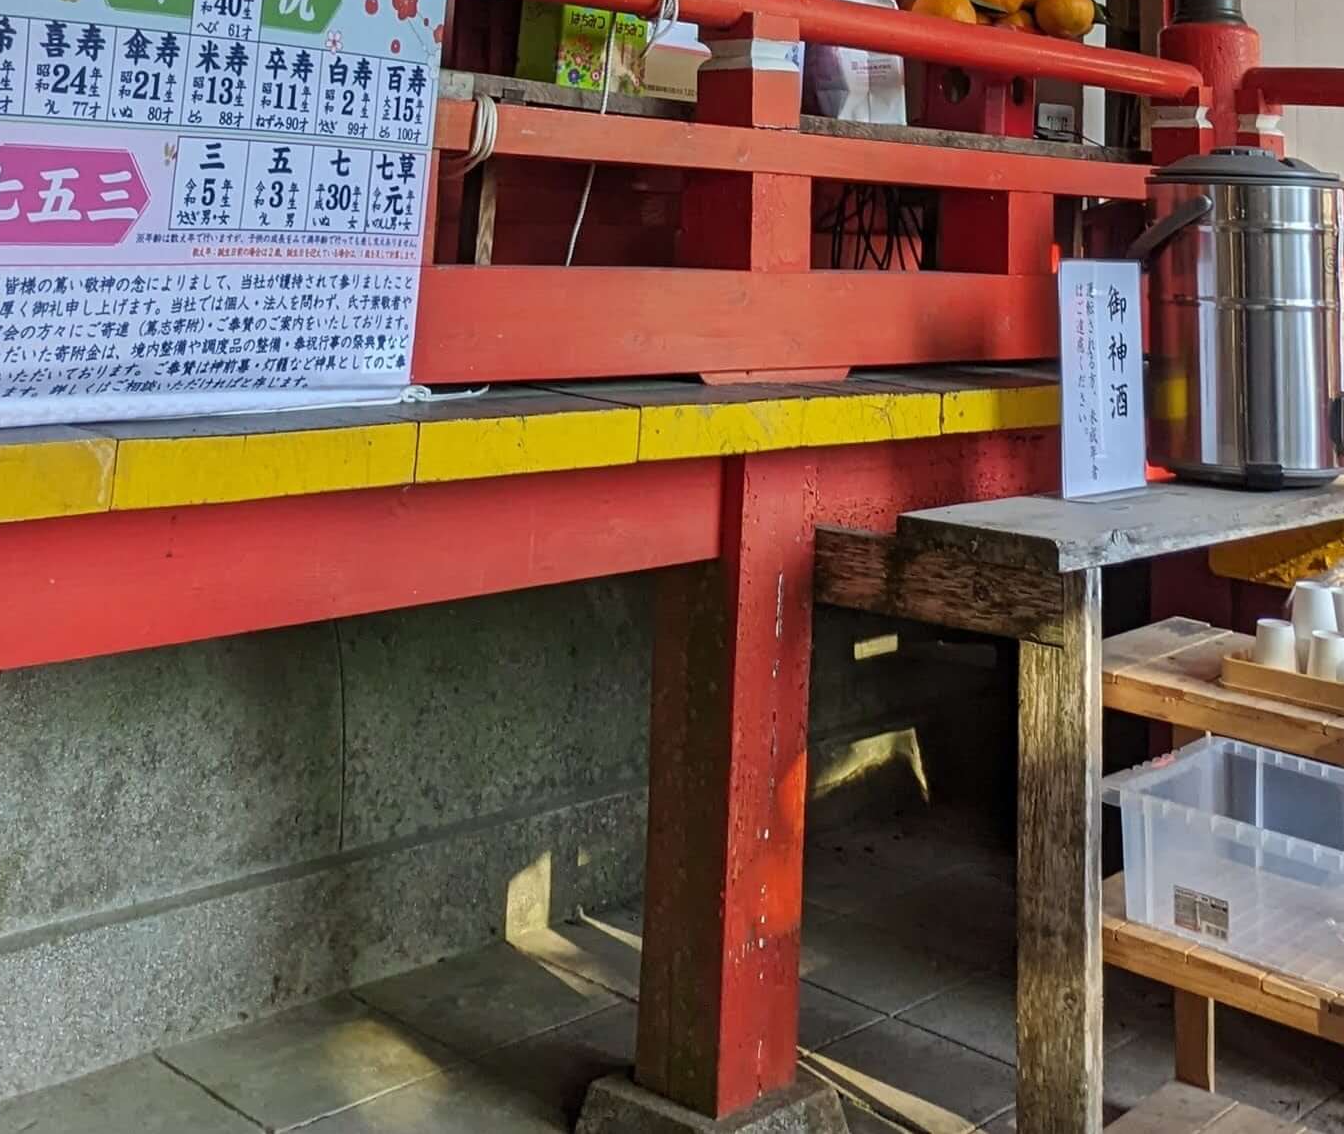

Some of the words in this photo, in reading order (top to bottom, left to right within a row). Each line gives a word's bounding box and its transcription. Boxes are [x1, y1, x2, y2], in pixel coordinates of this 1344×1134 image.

[229, 23, 251, 41] 61才
[570, 11, 606, 30] はちみつ
[40, 20, 106, 62] 喜寿
[123, 28, 181, 68] 傘寿
[196, 40, 249, 77] 米寿
[265, 47, 314, 83] 卒寿
[329, 56, 372, 90] 白寿
[387, 65, 426, 97] 百寿
[73, 102, 101, 118] 77才
[112, 106, 133, 118] いぬ
[148, 107, 173, 123] 80才
[219, 111, 244, 127] 88才
[286, 117, 308, 132] 90才
[347, 123, 368, 138] 99才
[398, 126, 422, 144] 100才
[200, 142, 225, 171] 三
[268, 146, 292, 174] 五
[330, 149, 351, 177] 七
[377, 153, 416, 184] 七草
[285, 212, 294, 228] 男
[348, 216, 357, 230] 女
[1107, 284, 1129, 419] 御神酒
